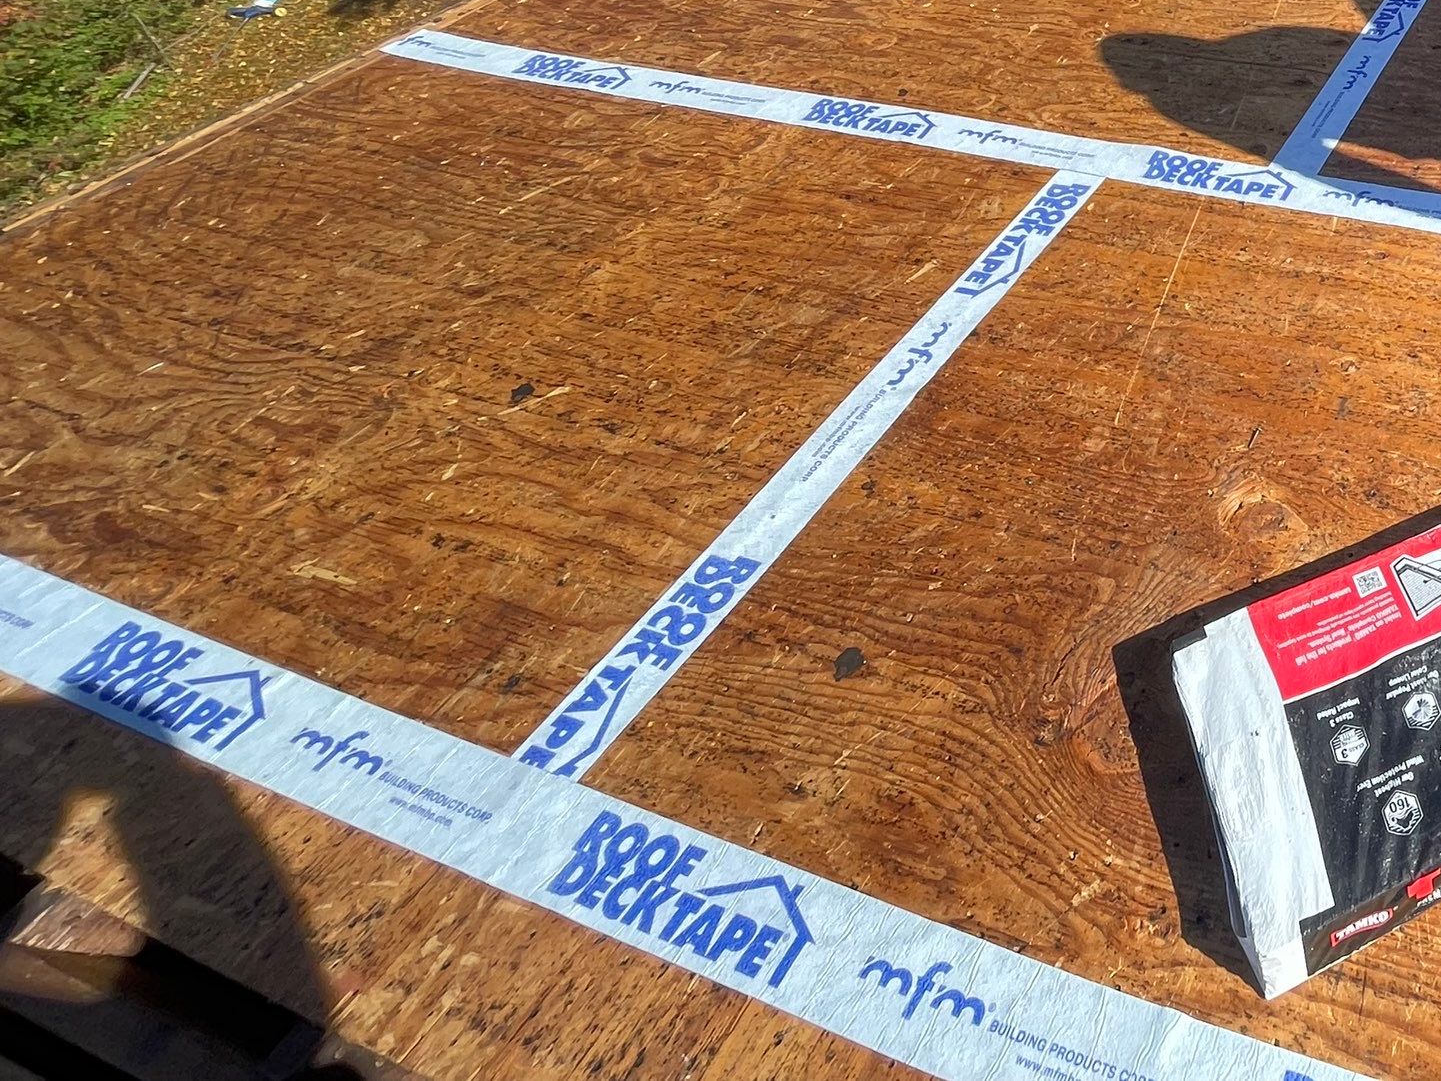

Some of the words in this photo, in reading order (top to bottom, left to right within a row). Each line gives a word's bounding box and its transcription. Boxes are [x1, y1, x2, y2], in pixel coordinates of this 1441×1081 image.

[523, 54, 587, 70] ROOF
[809, 99, 880, 115] ROOF
[1144, 162, 1216, 189] DECK
[1210, 176, 1278, 200] TAPE
[1147, 150, 1225, 176] ROOF
[1034, 183, 1091, 237] ROOF
[964, 234, 1028, 285] TAPE
[886, 321, 949, 386] mfm
[659, 555, 762, 672] ROOF
[92, 620, 205, 677] ROOF
[57, 650, 170, 712] DECK
[138, 682, 243, 744] TAPE
[290, 727, 383, 776] mfm
[379, 771, 422, 795] BUILDING
[418, 787, 468, 814] PRODUCTS
[1389, 796, 1410, 813] 160
[573, 809, 707, 889] ROOF
[547, 847, 680, 934] DECK
[657, 895, 784, 979] TAPE
[1336, 910, 1389, 941] TAMKO
[858, 956, 985, 1026] mfm
[989, 1019, 1047, 1052] BUILDING
[1049, 1042, 1117, 1079] PRODUCTS
